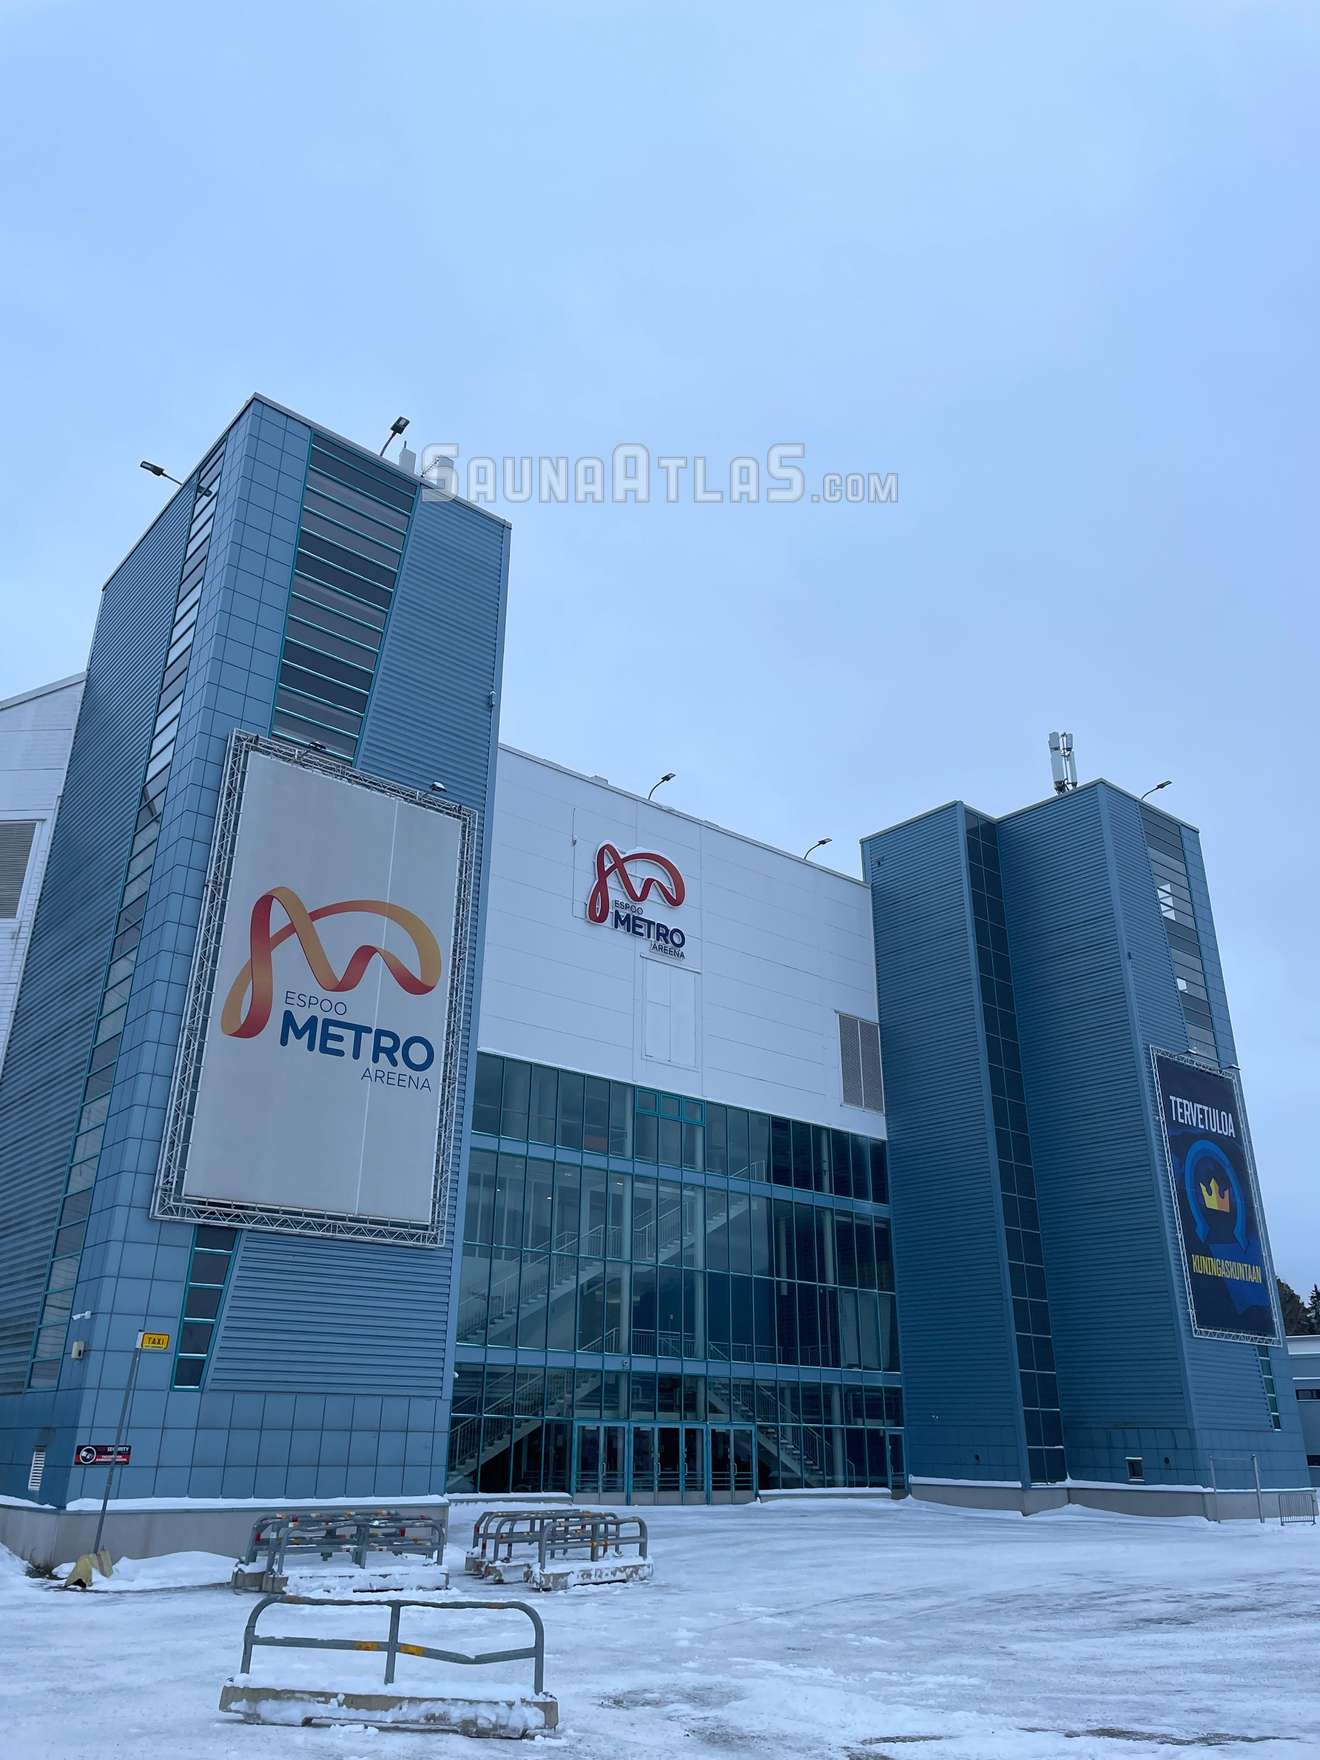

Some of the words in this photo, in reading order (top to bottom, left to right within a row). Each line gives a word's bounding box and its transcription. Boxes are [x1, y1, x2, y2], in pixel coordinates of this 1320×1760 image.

[614, 900, 644, 915] ESPOO
[614, 910, 686, 949] METRO
[652, 943, 686, 960] AREENA
[284, 990, 347, 1016] ESPOO
[279, 1009, 435, 1072] METRO
[360, 1067, 432, 1093] AREENA
[1169, 1095, 1236, 1138] TERVETULOA
[1191, 1254, 1262, 1284] KUNINGASKUNTAAN
[148, 1336, 165, 1345] TAXI
